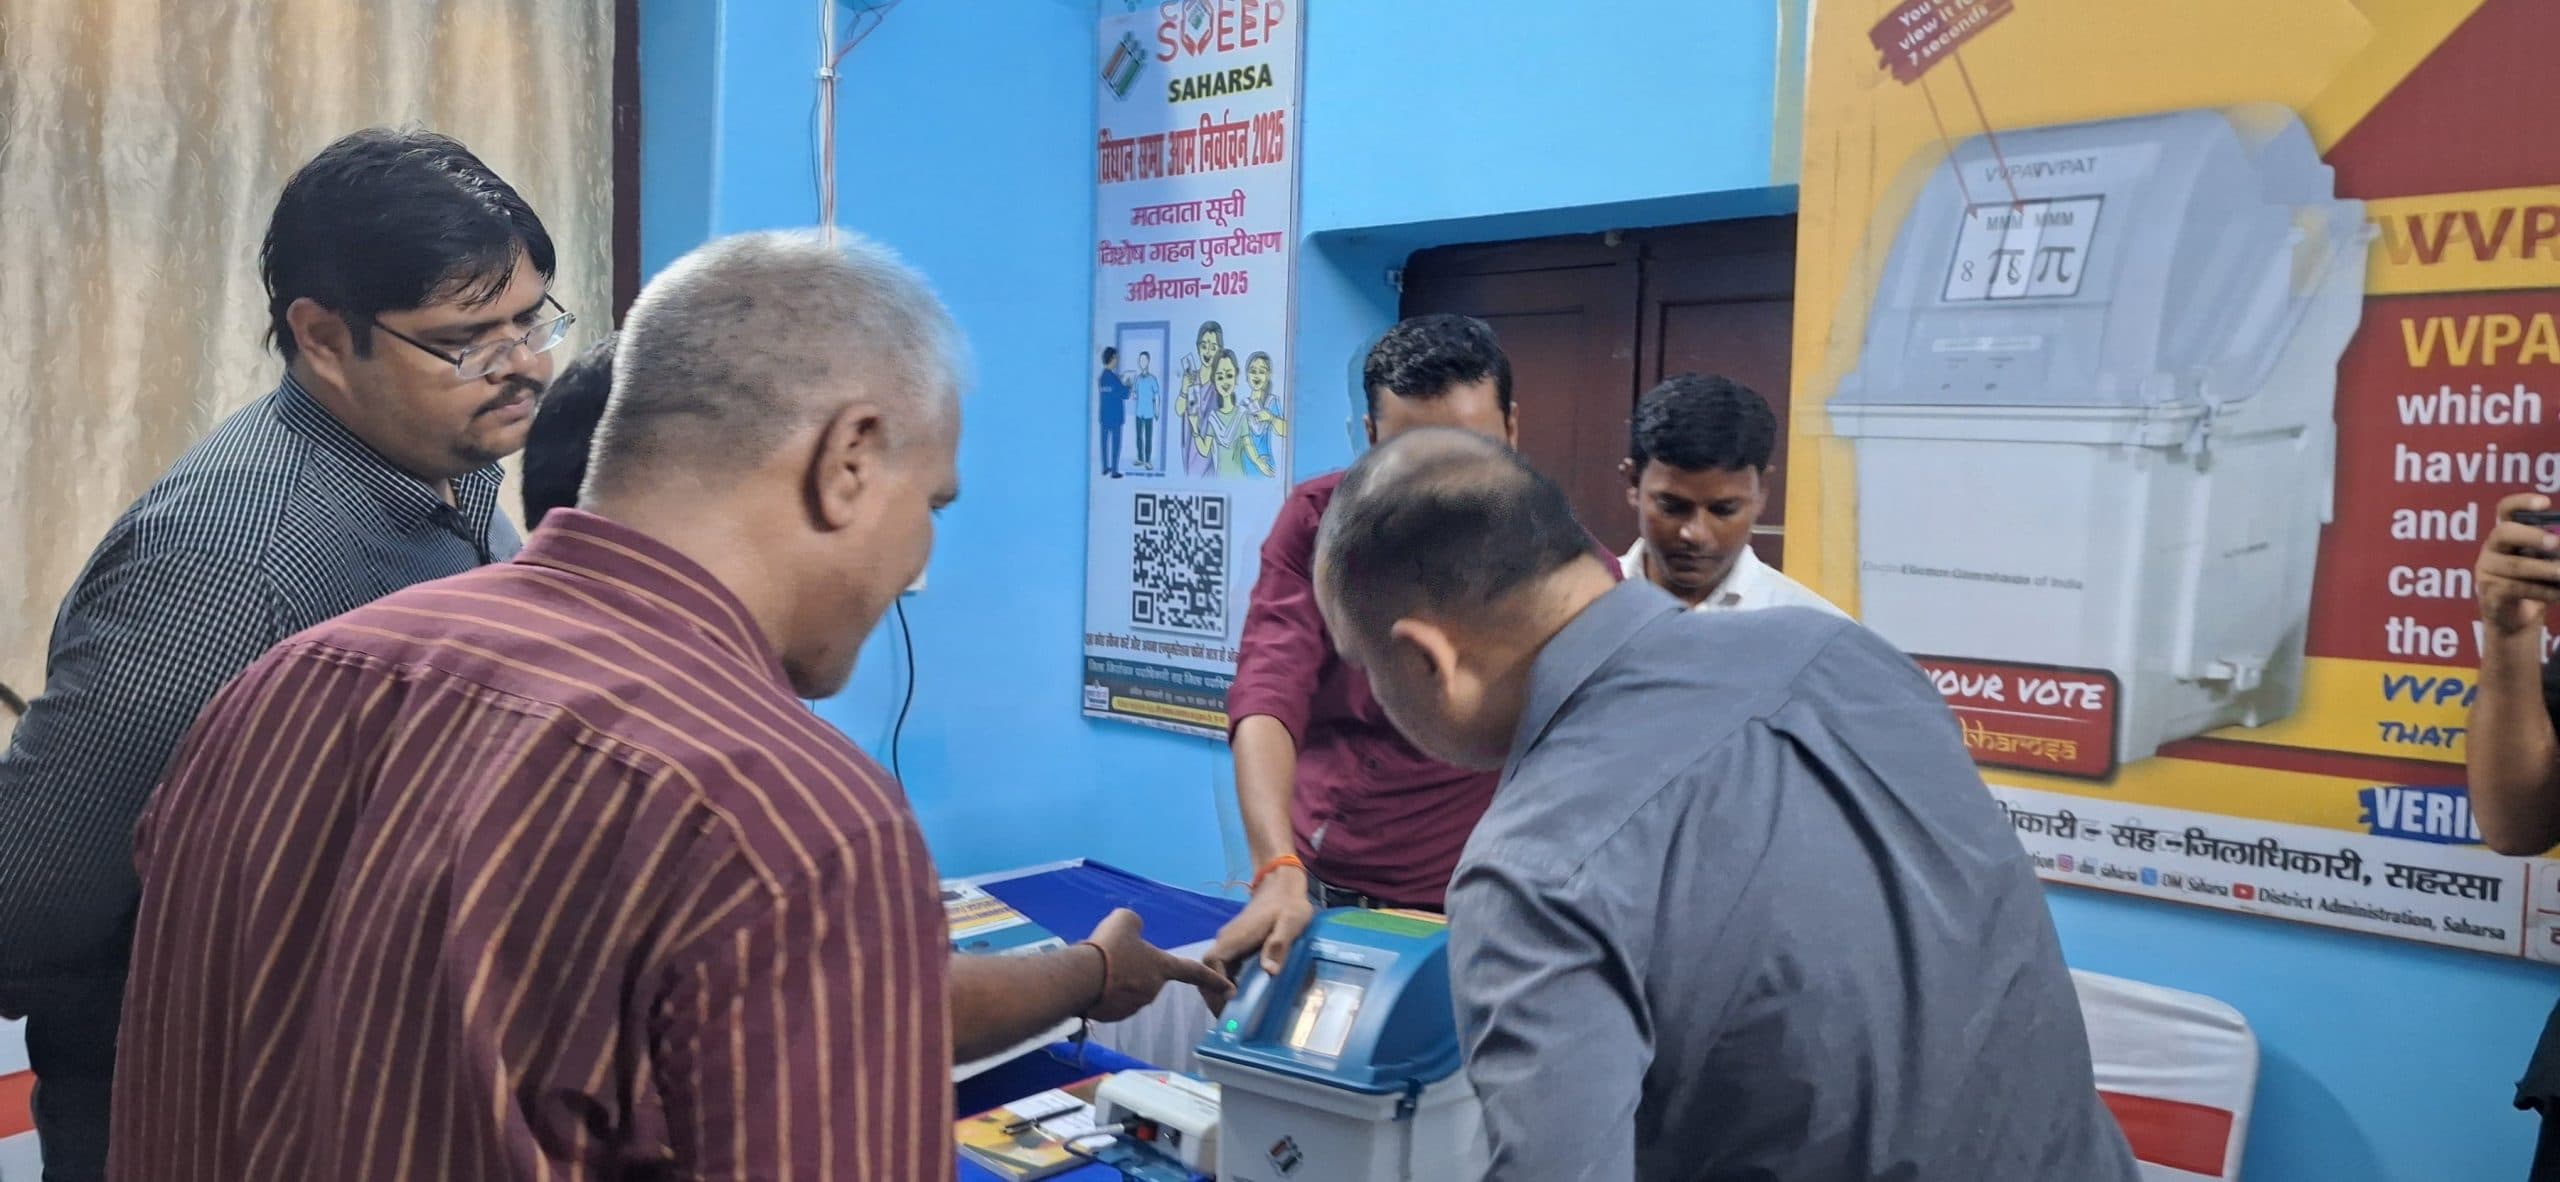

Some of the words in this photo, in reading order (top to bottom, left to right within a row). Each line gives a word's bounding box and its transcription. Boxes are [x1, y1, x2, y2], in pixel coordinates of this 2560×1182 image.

[1898, 2, 1931, 27] You
[1898, 17, 1938, 50] view
[1908, 51, 1919, 67] 7
[1921, 4, 1989, 58] seconds
[1168, 63, 1273, 103] SAHARSA
[1098, 128, 1135, 184] विधान
[1138, 132, 1165, 179] सभा
[1167, 129, 1197, 177] आम
[1199, 109, 1250, 172] निर्वाचन
[1252, 110, 1284, 166] 2025
[1131, 200, 1202, 227] मतदाता
[1205, 189, 1246, 227] सूची
[1098, 239, 1146, 267] विशेष
[1149, 239, 1195, 264] गहन
[1198, 228, 1283, 267] पुनरीक्षण
[2401, 313, 2560, 367] VVPA
[2397, 383, 2542, 425] which
[2394, 443, 2560, 493] having
[2390, 502, 2479, 541] and
[2388, 565, 2472, 599] can
[2385, 616, 2459, 658] the
[2018, 677, 2106, 710] VOTE
[2378, 721, 2469, 748] THAT
[2109, 822, 2158, 851] सह
[2384, 861, 2503, 903] सहरसा
[2258, 887, 2313, 911] District
[2318, 897, 2437, 932] Administration,
[2443, 916, 2505, 941] Saharsa
